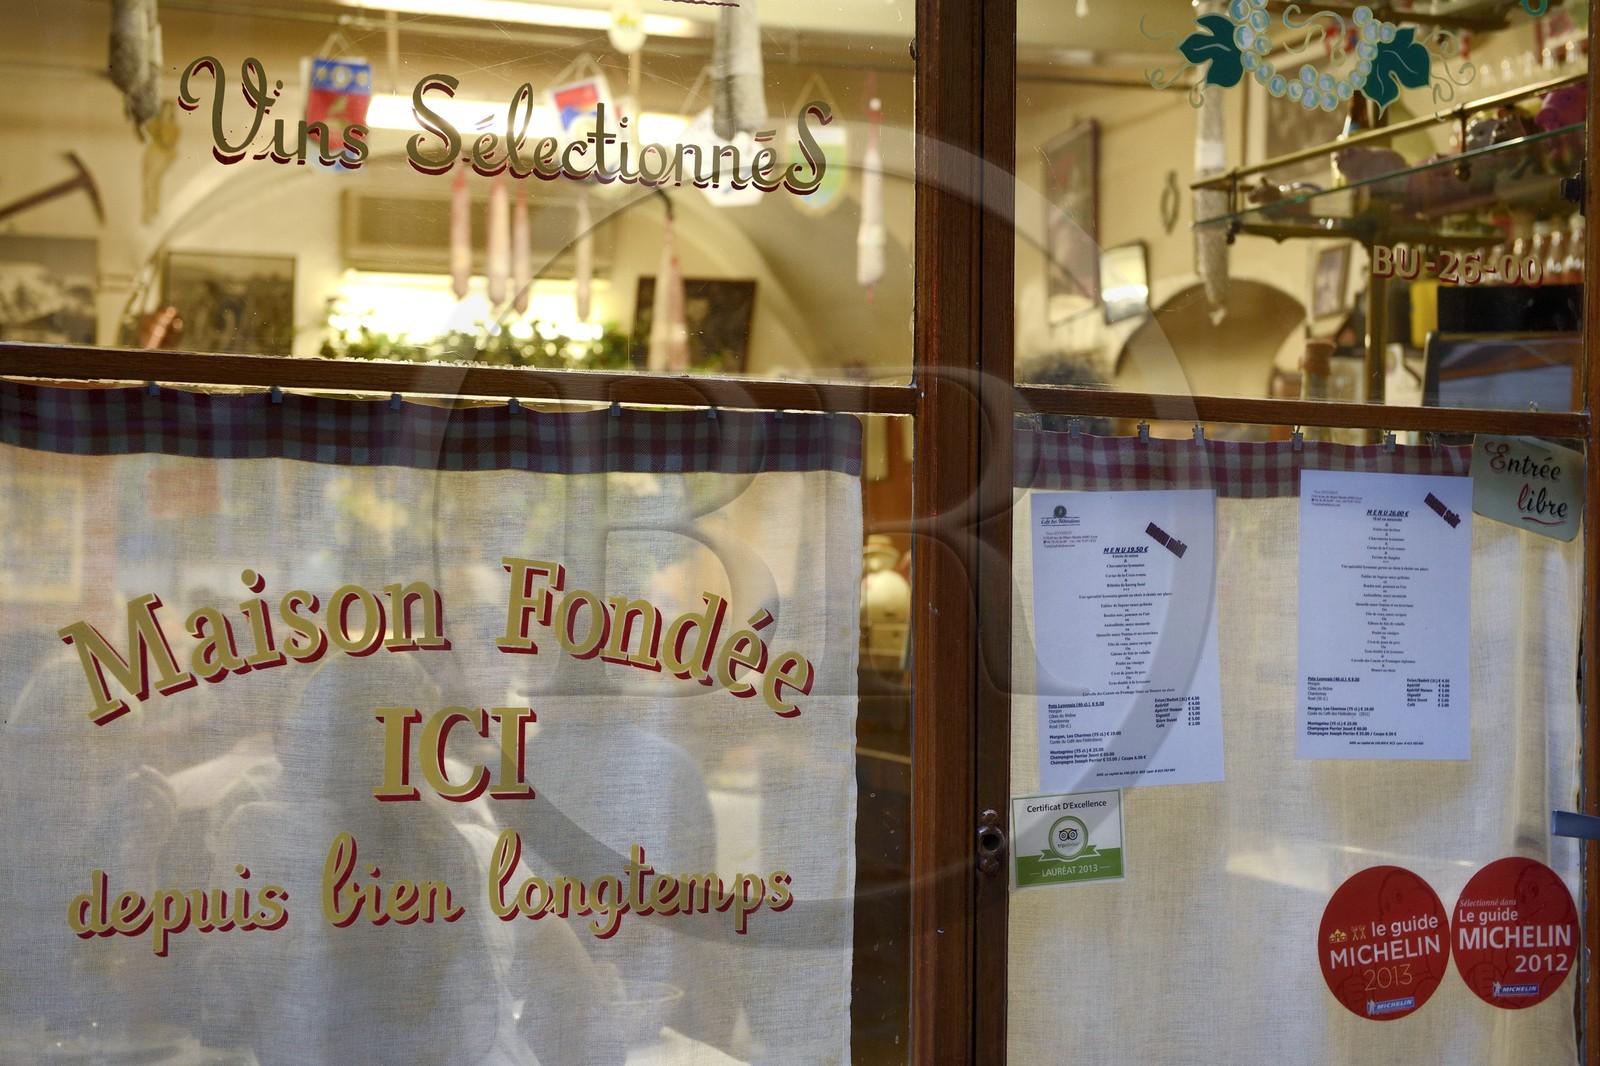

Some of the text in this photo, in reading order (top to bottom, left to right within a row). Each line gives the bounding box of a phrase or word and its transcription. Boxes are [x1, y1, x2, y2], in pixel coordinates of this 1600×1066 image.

[178, 56, 370, 169] Vins
[1372, 245, 1544, 288] BU-26-00
[1484, 442, 1562, 480] Entrée
[1518, 483, 1568, 518] libre
[57, 556, 814, 727] Maison Fondée
[372, 706, 537, 803] ICI
[1026, 800, 1107, 813] Certificat D'Excellence
[1042, 864, 1098, 877] LAURÉAT 2013
[67, 828, 794, 958] depuis bien longtemps
[1459, 898, 1498, 907] Sélectionné
[1372, 914, 1438, 938] le guide
[1459, 907, 1518, 925] Le guide
[1459, 924, 1571, 950] MICHELIN
[1330, 934, 1440, 970] MICHELIN
[1515, 954, 1568, 973] 2012
[1364, 964, 1413, 991] 2013
[1376, 999, 1413, 1010] MICHELIN
